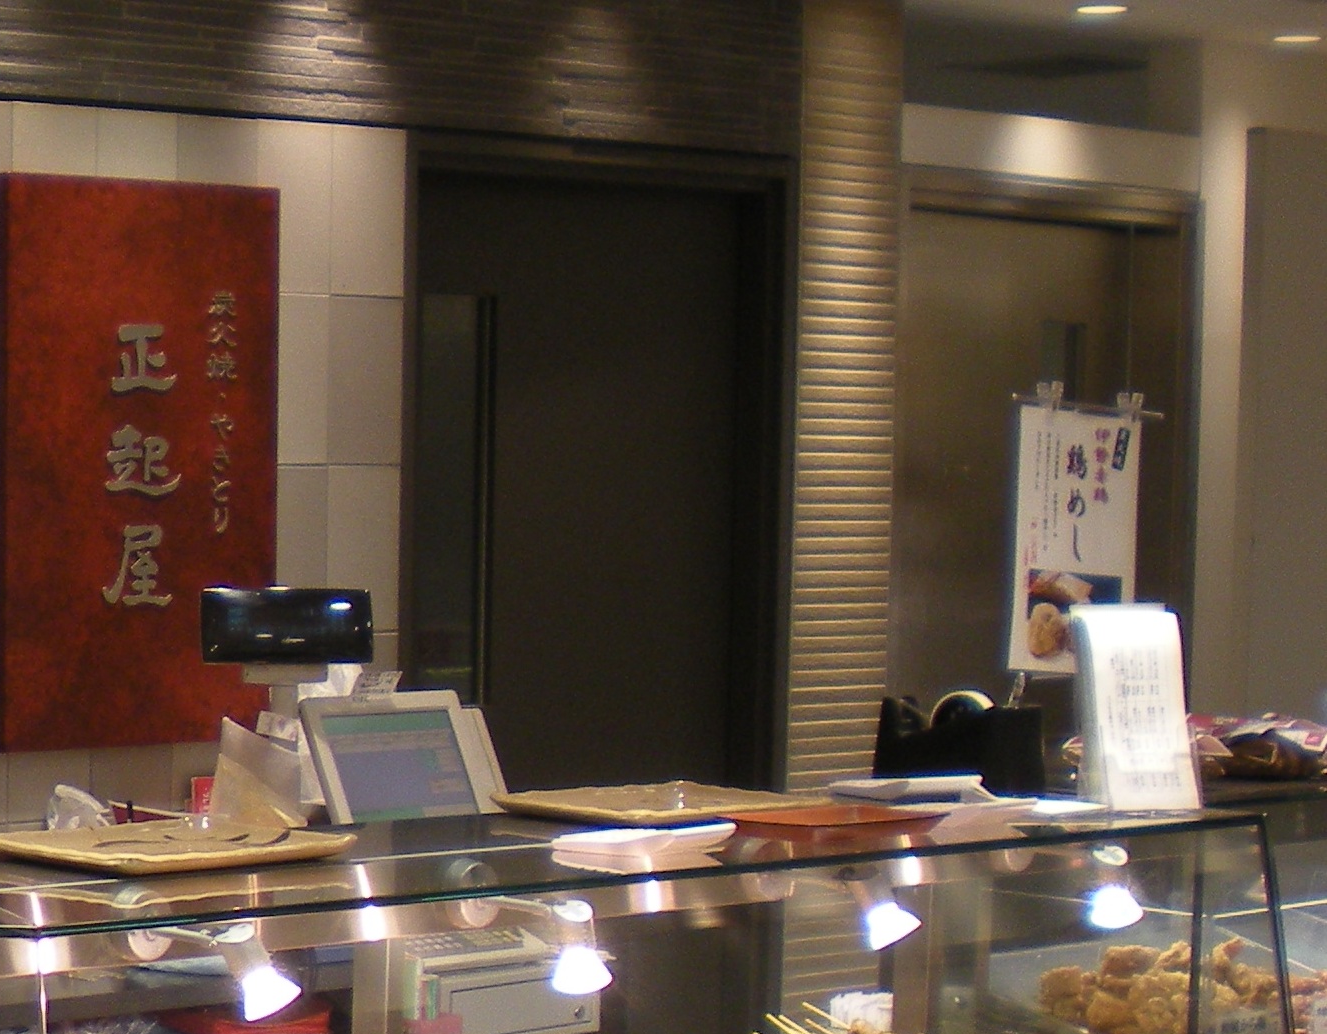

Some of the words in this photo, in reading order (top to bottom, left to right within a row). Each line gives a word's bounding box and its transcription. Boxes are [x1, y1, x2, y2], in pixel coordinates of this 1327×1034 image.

[103, 322, 183, 608] 正起屋
[1066, 443, 1088, 563] 鶏めし
